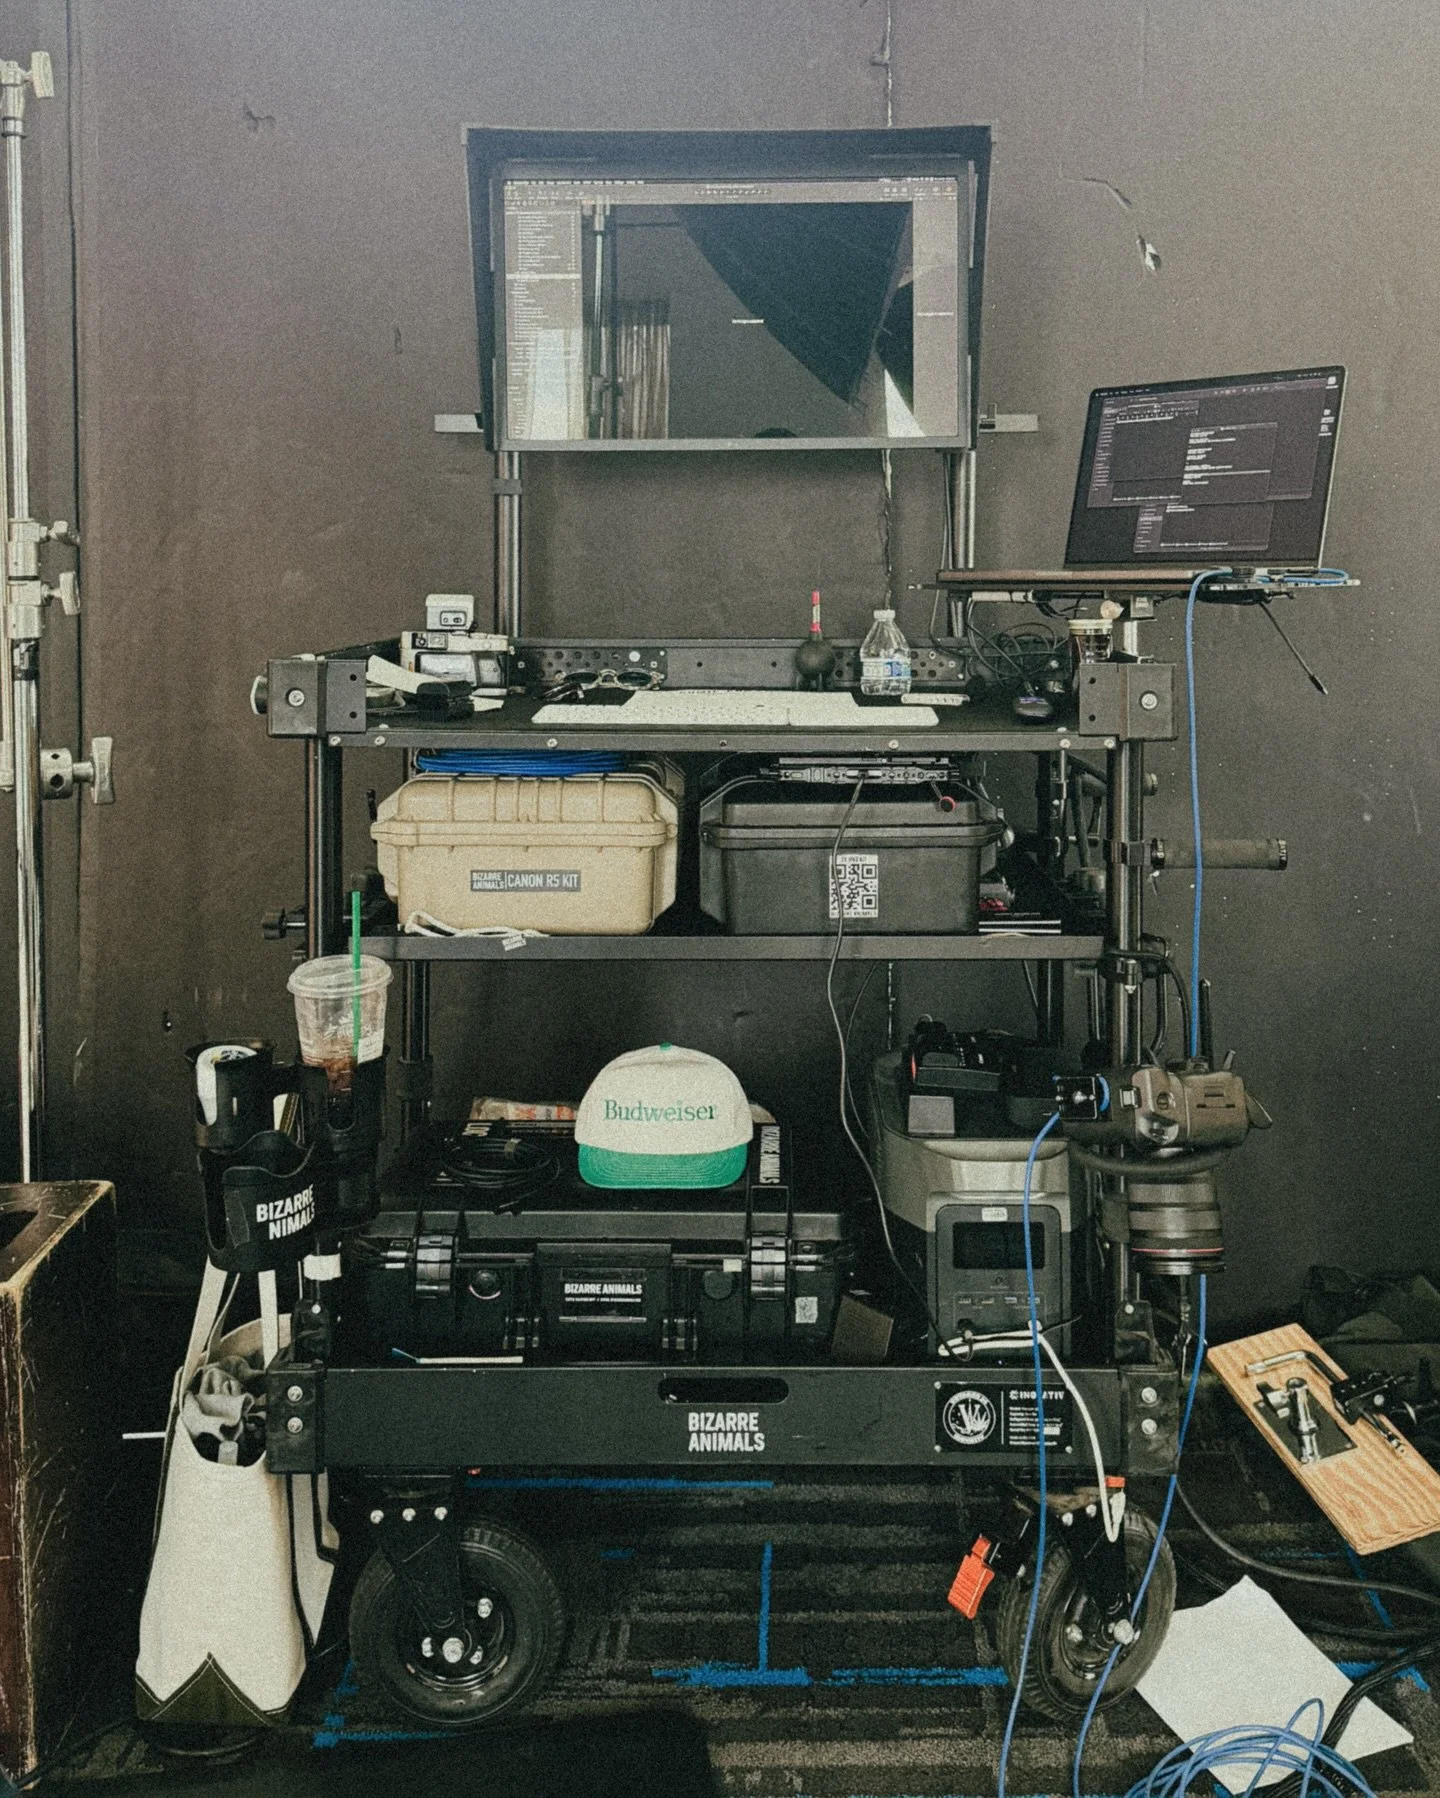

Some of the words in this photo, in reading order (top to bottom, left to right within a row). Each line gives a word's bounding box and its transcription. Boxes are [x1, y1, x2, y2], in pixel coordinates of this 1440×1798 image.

[472, 872, 502, 881] BIZARRE
[507, 873, 543, 888] CANON
[546, 874, 560, 888] R5
[562, 874, 579, 888] KIT
[472, 881, 505, 890] ANIMALS
[603, 1099, 716, 1121] Budweiser
[256, 1183, 314, 1223] BIZARRE
[564, 1283, 602, 1294] BIZARRE
[602, 1283, 642, 1294] ANIMALS
[1020, 1391, 1065, 1400] INOATIV
[688, 1412, 759, 1431] BIZARRE
[688, 1432, 765, 1452] ANIMALS
